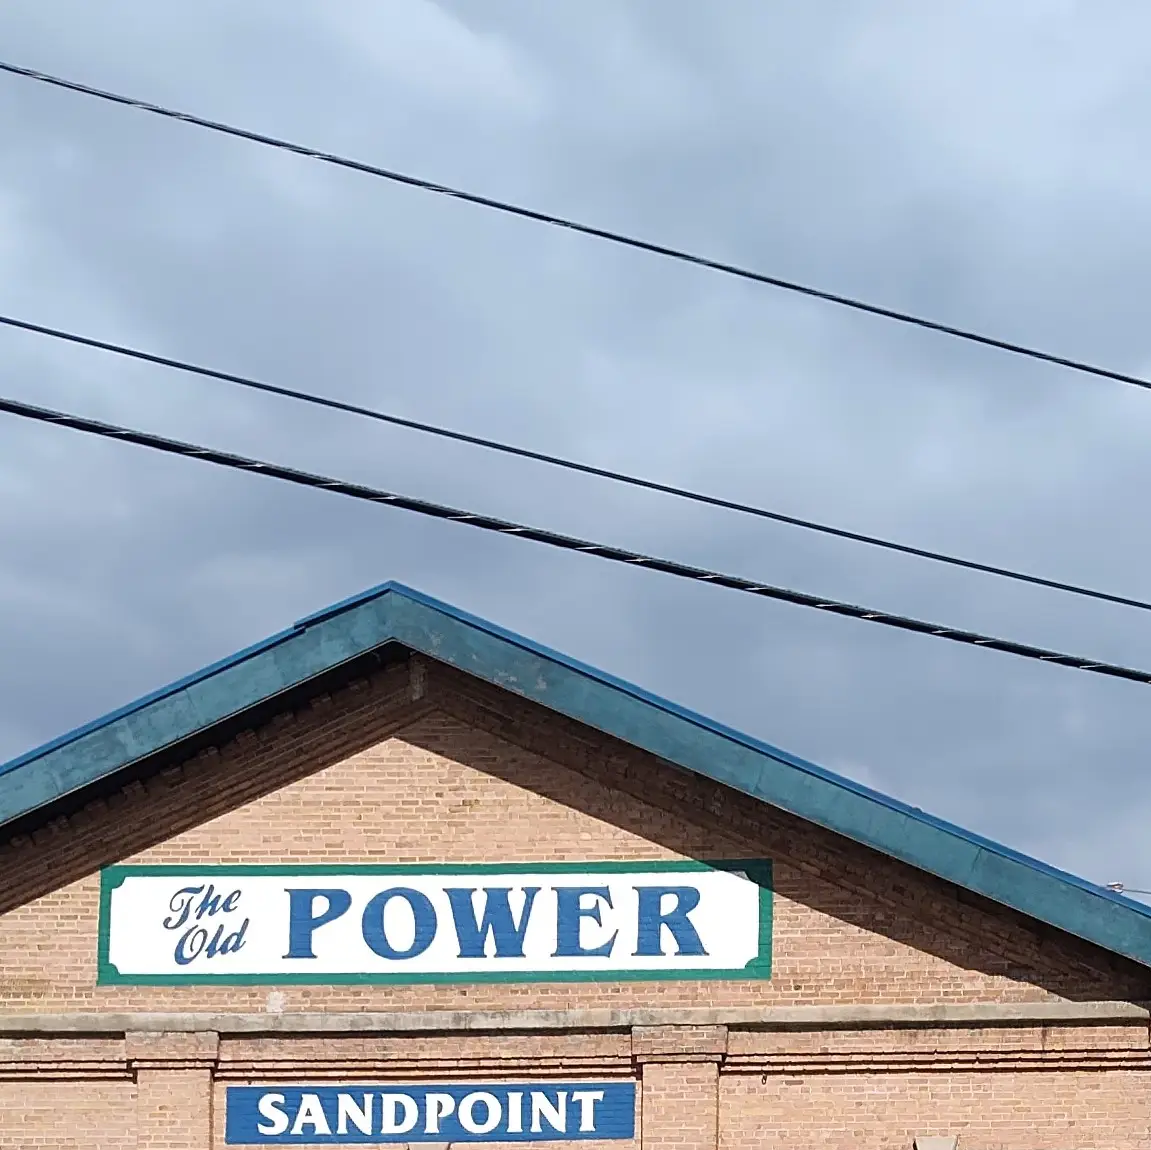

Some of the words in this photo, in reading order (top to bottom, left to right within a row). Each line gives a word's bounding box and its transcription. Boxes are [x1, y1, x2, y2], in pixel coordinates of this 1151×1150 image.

[163, 884, 242, 930] The
[282, 885, 710, 959] POWER
[174, 917, 249, 965] Old
[256, 1091, 605, 1137] SANDPOINT
